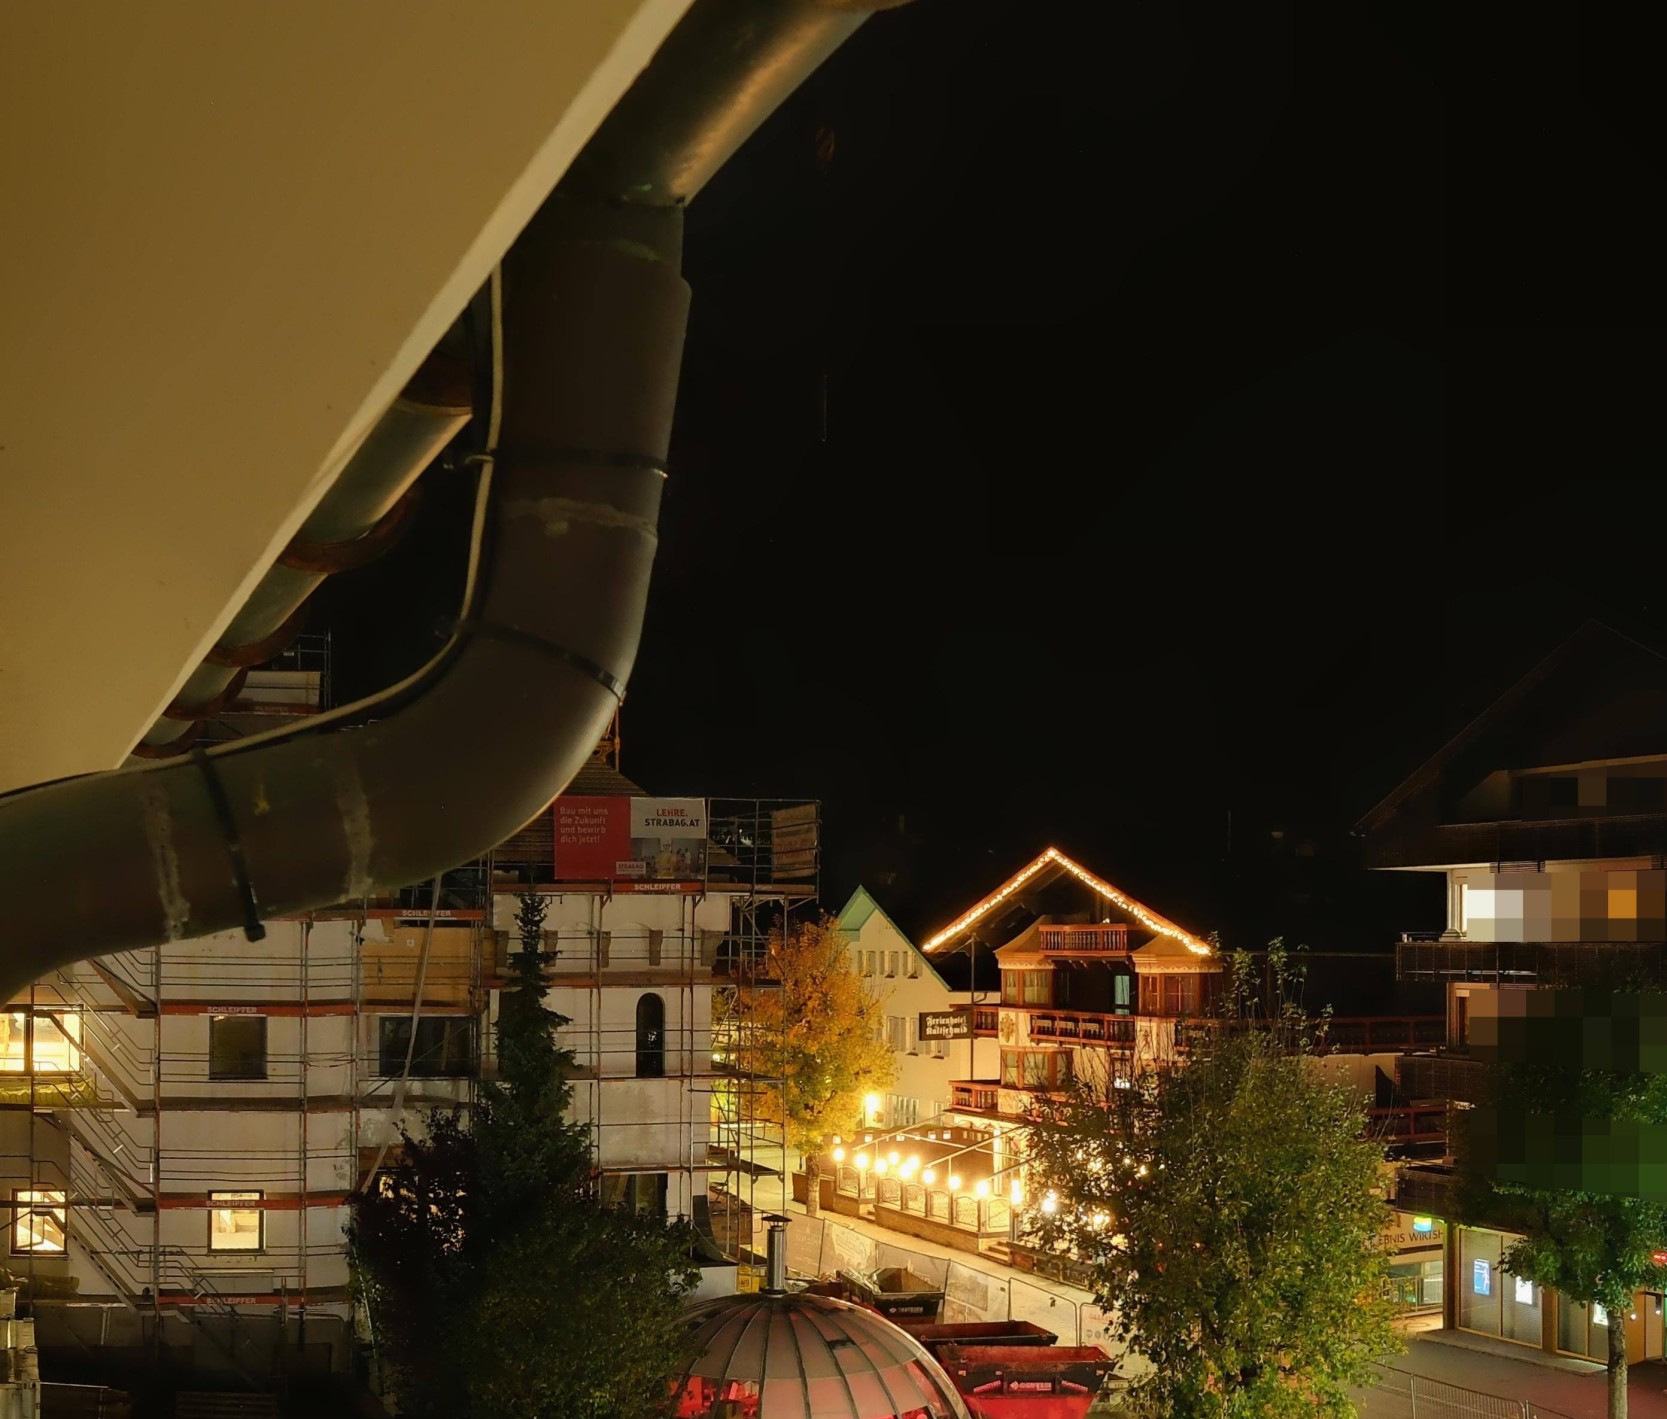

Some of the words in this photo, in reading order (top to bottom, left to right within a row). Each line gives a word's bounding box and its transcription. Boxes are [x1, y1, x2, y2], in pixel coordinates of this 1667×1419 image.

[560, 807, 575, 815] Bau
[578, 807, 591, 815] mit
[656, 808, 688, 817] LEHRE.
[560, 816, 573, 824] die
[574, 816, 606, 824] Zukunft
[644, 818, 700, 828] STRABAG.AT
[577, 826, 606, 834] bewirb
[560, 835, 577, 843] dich
[401, 909, 452, 917] SCHLEFER
[207, 1006, 257, 1014] SCHLEIPFER
